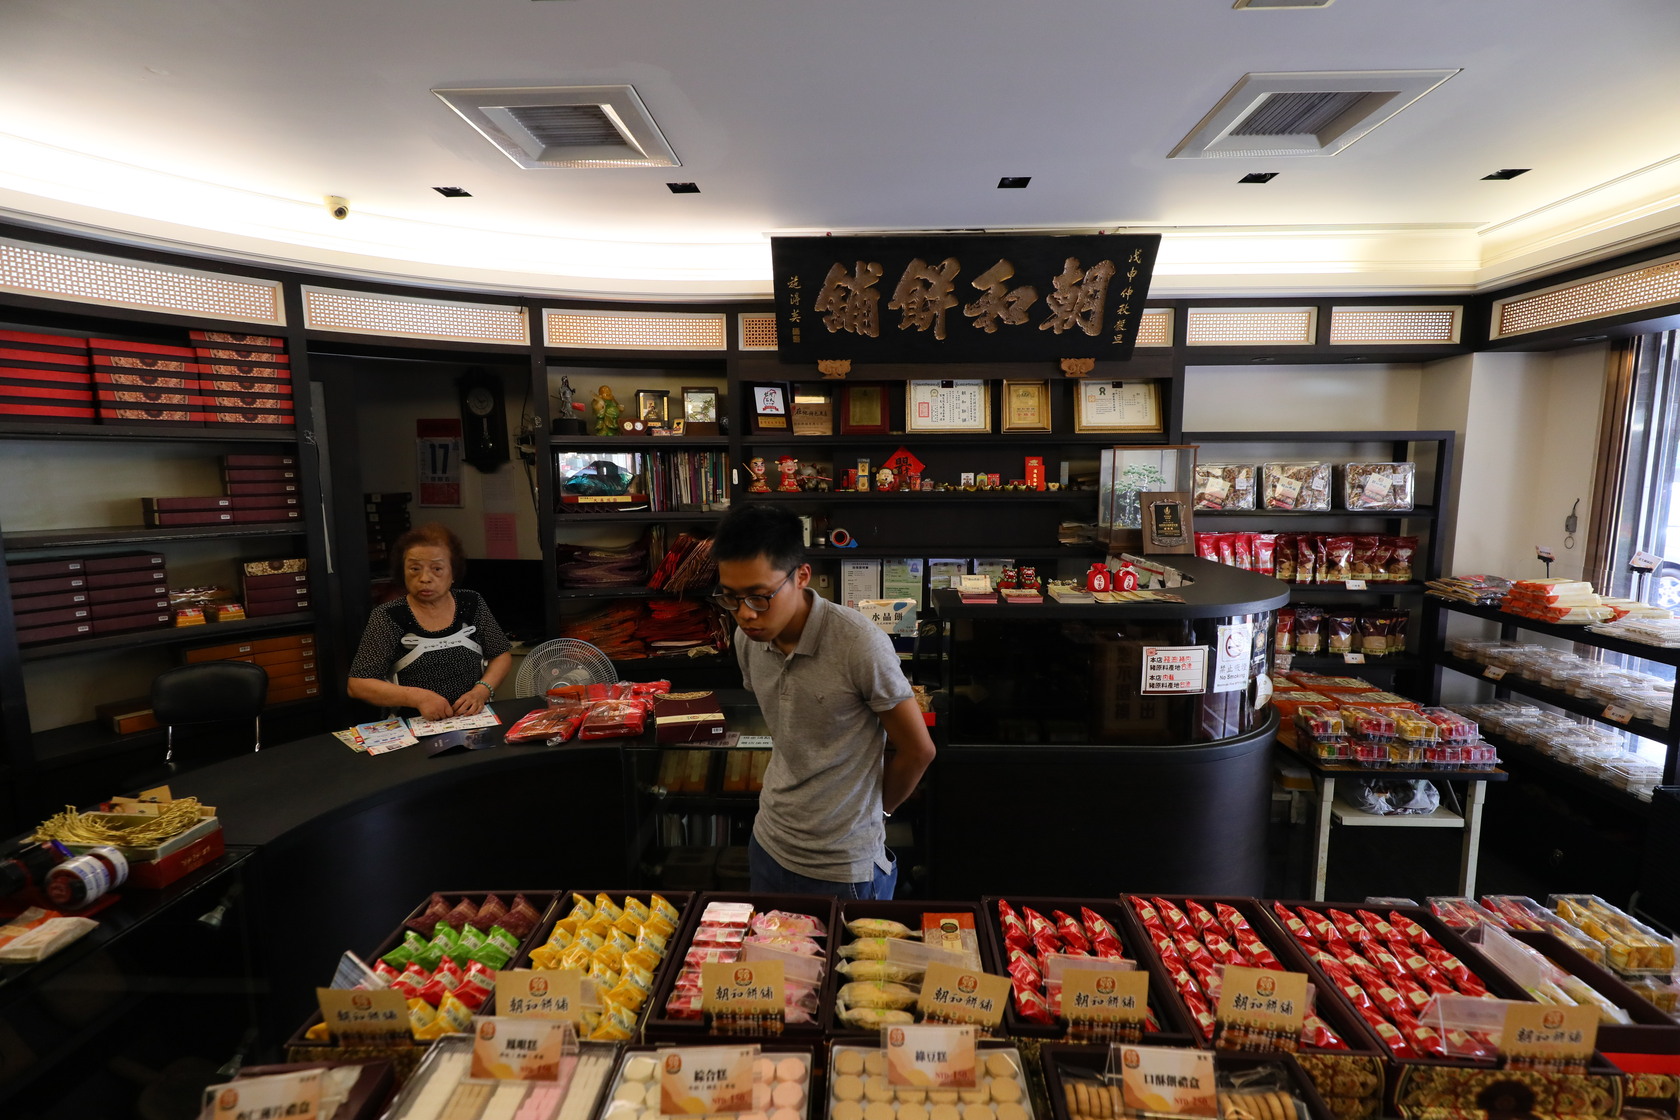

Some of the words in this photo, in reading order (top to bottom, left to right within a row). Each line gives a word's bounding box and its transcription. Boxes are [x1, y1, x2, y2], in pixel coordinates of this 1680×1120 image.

[429, 443, 449, 475] 17
[915, 1050, 948, 1063] 綠豆糕
[694, 1068, 727, 1082] 綜合糕
